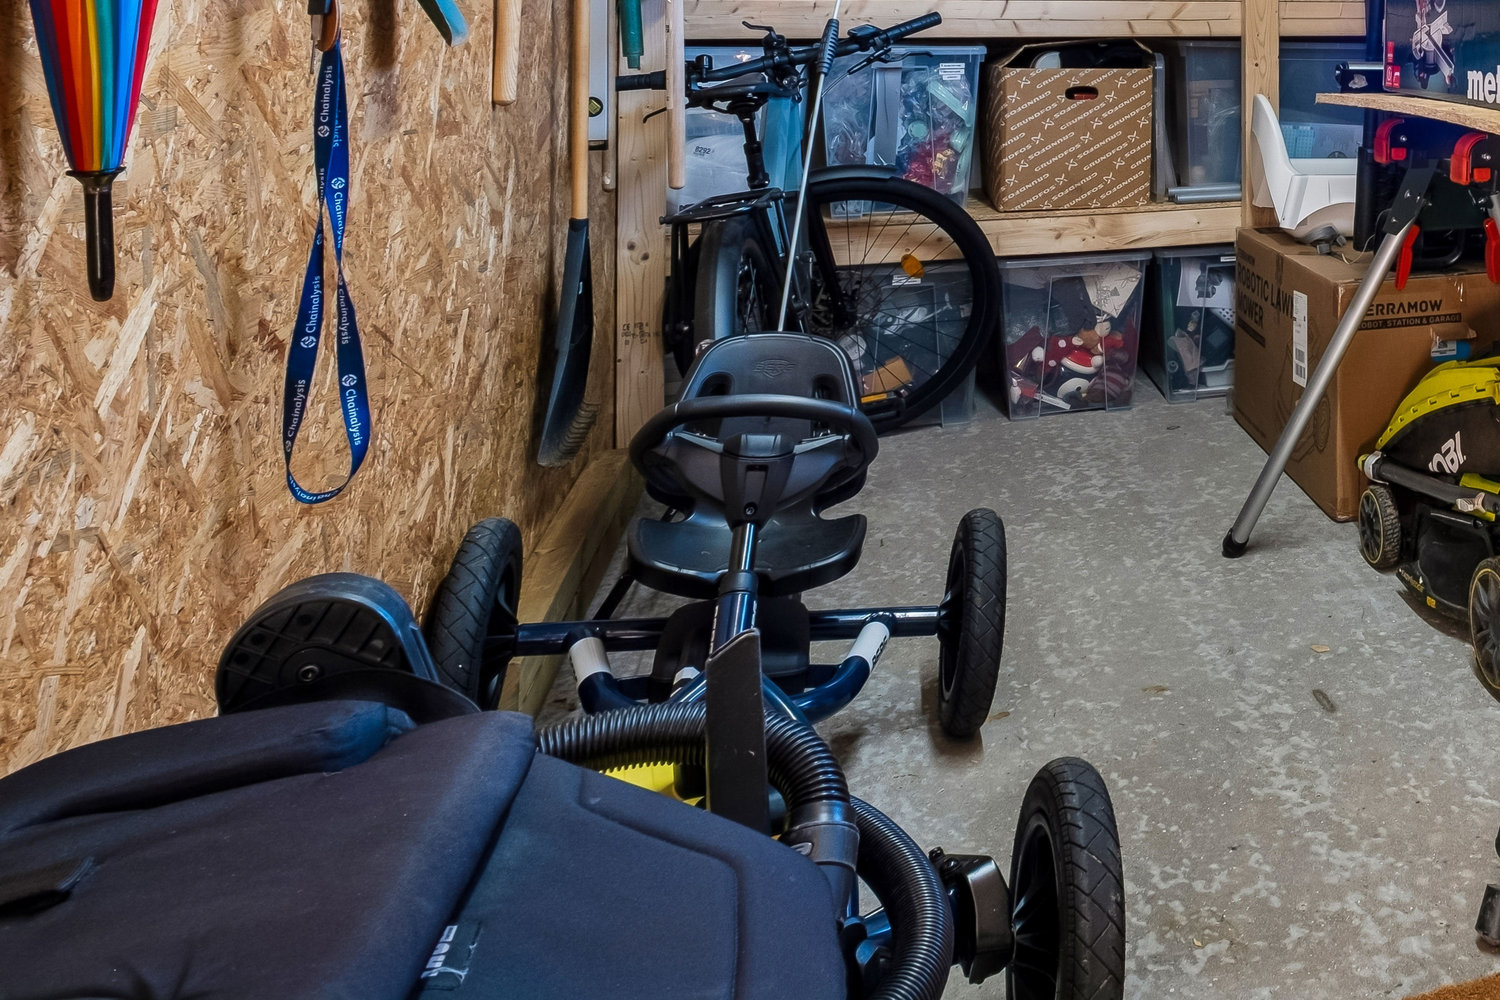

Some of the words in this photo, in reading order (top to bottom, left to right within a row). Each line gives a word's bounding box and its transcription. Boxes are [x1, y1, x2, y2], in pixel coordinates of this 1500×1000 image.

[321, 65, 333, 122] Chainalysis
[1005, 90, 1051, 119] GRUNDFOS
[1102, 90, 1146, 118] GRUNDFOS
[1010, 102, 1058, 131] GRUNDFOS
[1060, 101, 1106, 130] GRUNDFOS
[1028, 131, 1075, 160] GRUNDFOS
[1034, 143, 1081, 172] GRUNDFOS
[1077, 131, 1122, 159] GRUNDFOS
[1083, 142, 1128, 171] GRUNDFOS
[1003, 173, 1049, 201] GRUNDFOS
[1052, 172, 1098, 200] GRUNDFOS
[1100, 170, 1144, 199] GRUNDFOS
[1237, 262, 1270, 303] ROBOTIC
[308, 275, 321, 333] Chainalysis
[339, 288, 349, 345] Chainalysis
[1386, 317, 1421, 328] STATION
[1428, 314, 1461, 324] GARAGE
[288, 379, 305, 438] Chainalysis
[345, 389, 361, 446] Chainalysis
